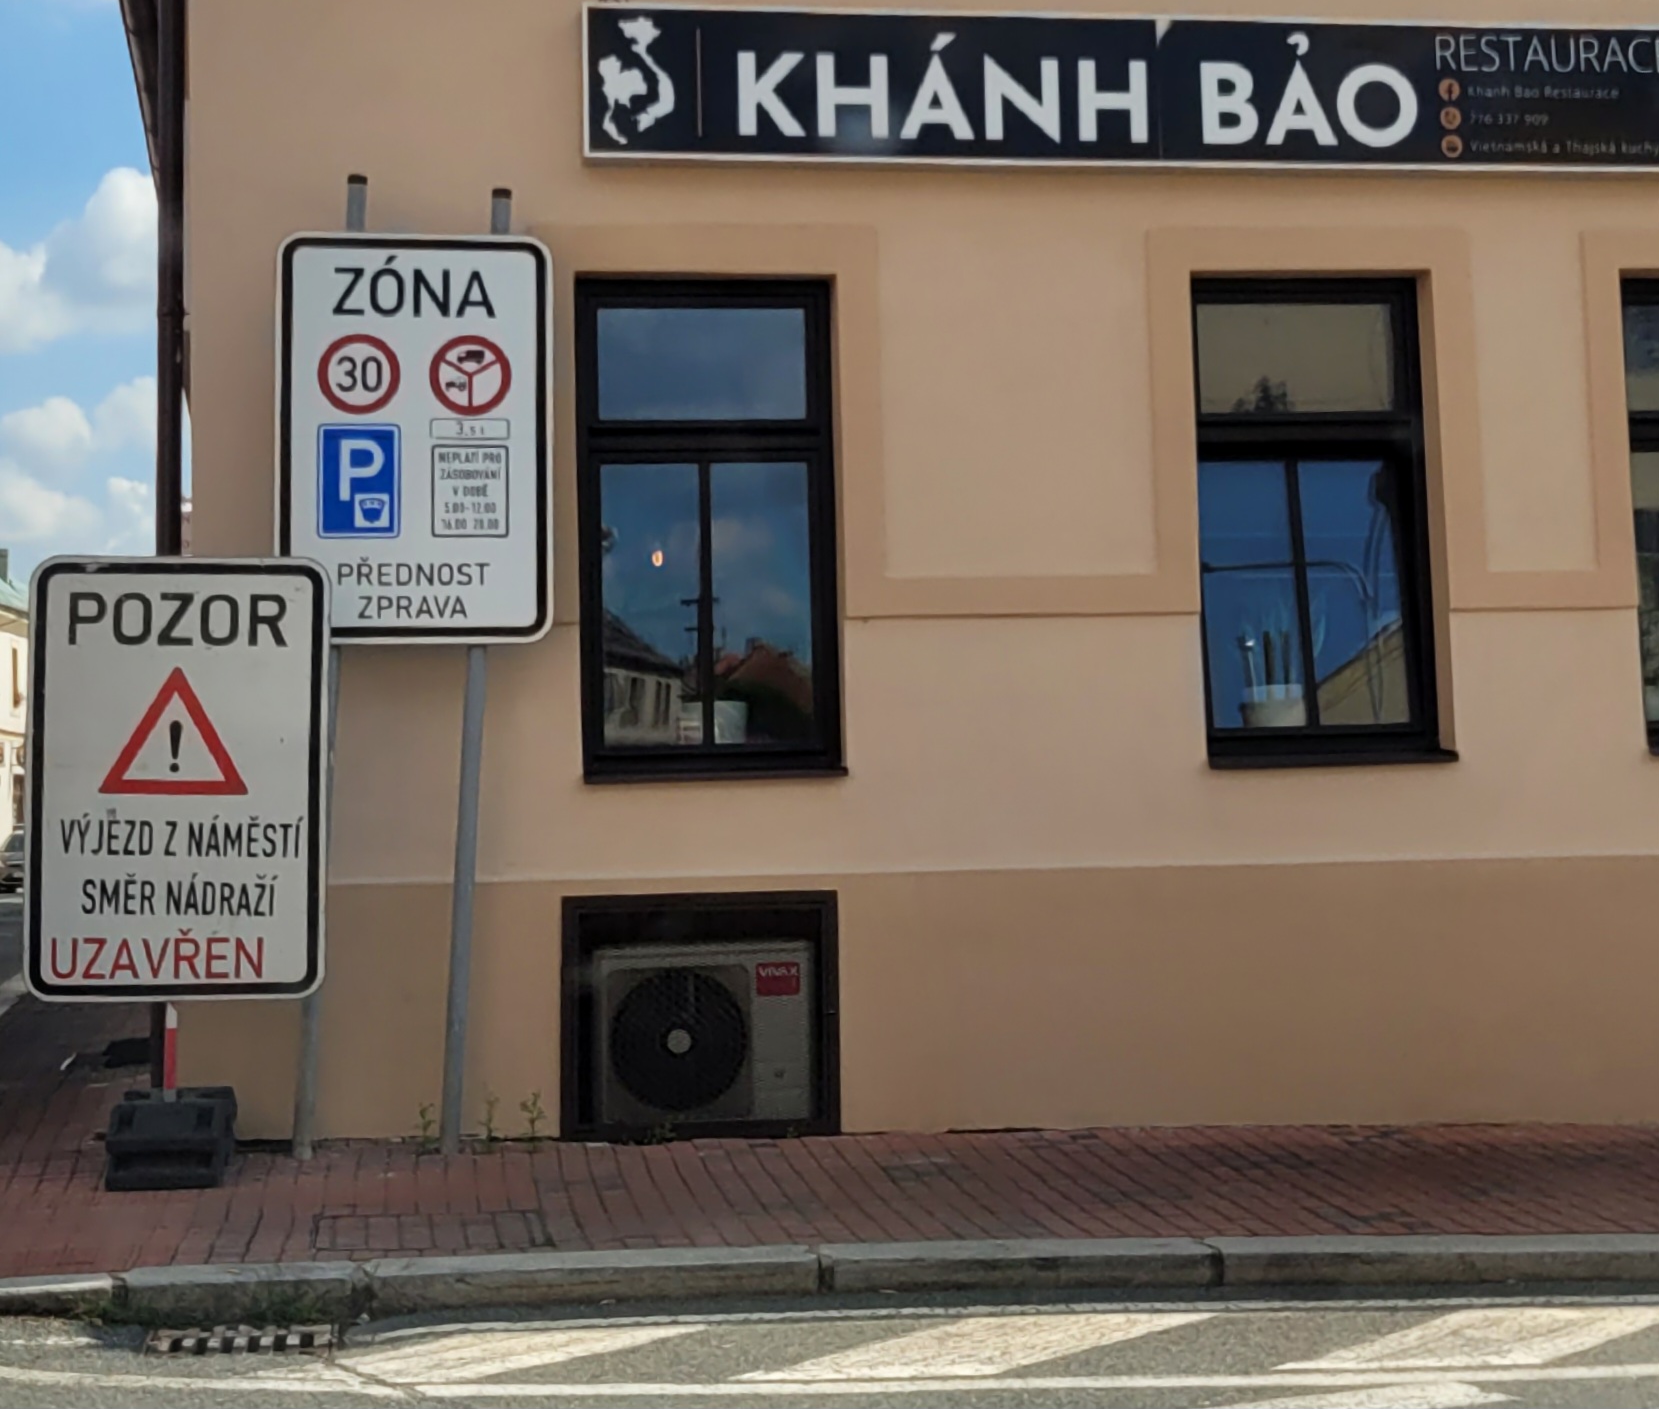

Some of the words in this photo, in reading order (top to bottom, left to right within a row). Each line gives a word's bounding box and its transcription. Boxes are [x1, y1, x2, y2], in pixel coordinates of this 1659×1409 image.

[1435, 34, 1659, 74] RESTAURAC
[736, 32, 1148, 143] KHÁNH
[1200, 31, 1418, 147] BẢO
[332, 255, 496, 319] ZÓNA
[336, 355, 383, 394] 30
[339, 439, 385, 501] P
[482, 452, 502, 464] PRO
[337, 557, 490, 586] PŘEDNOST
[68, 591, 289, 648] POZOR
[357, 596, 468, 620] ZPRAVA
[60, 812, 153, 856] VÝJEZD
[163, 820, 177, 856] Z
[188, 815, 304, 858] NÁMĚSTÍ
[81, 874, 156, 915] SMĚR
[166, 873, 279, 917] NÁDRAŽÍ
[50, 929, 264, 980] UZAVŘEN
